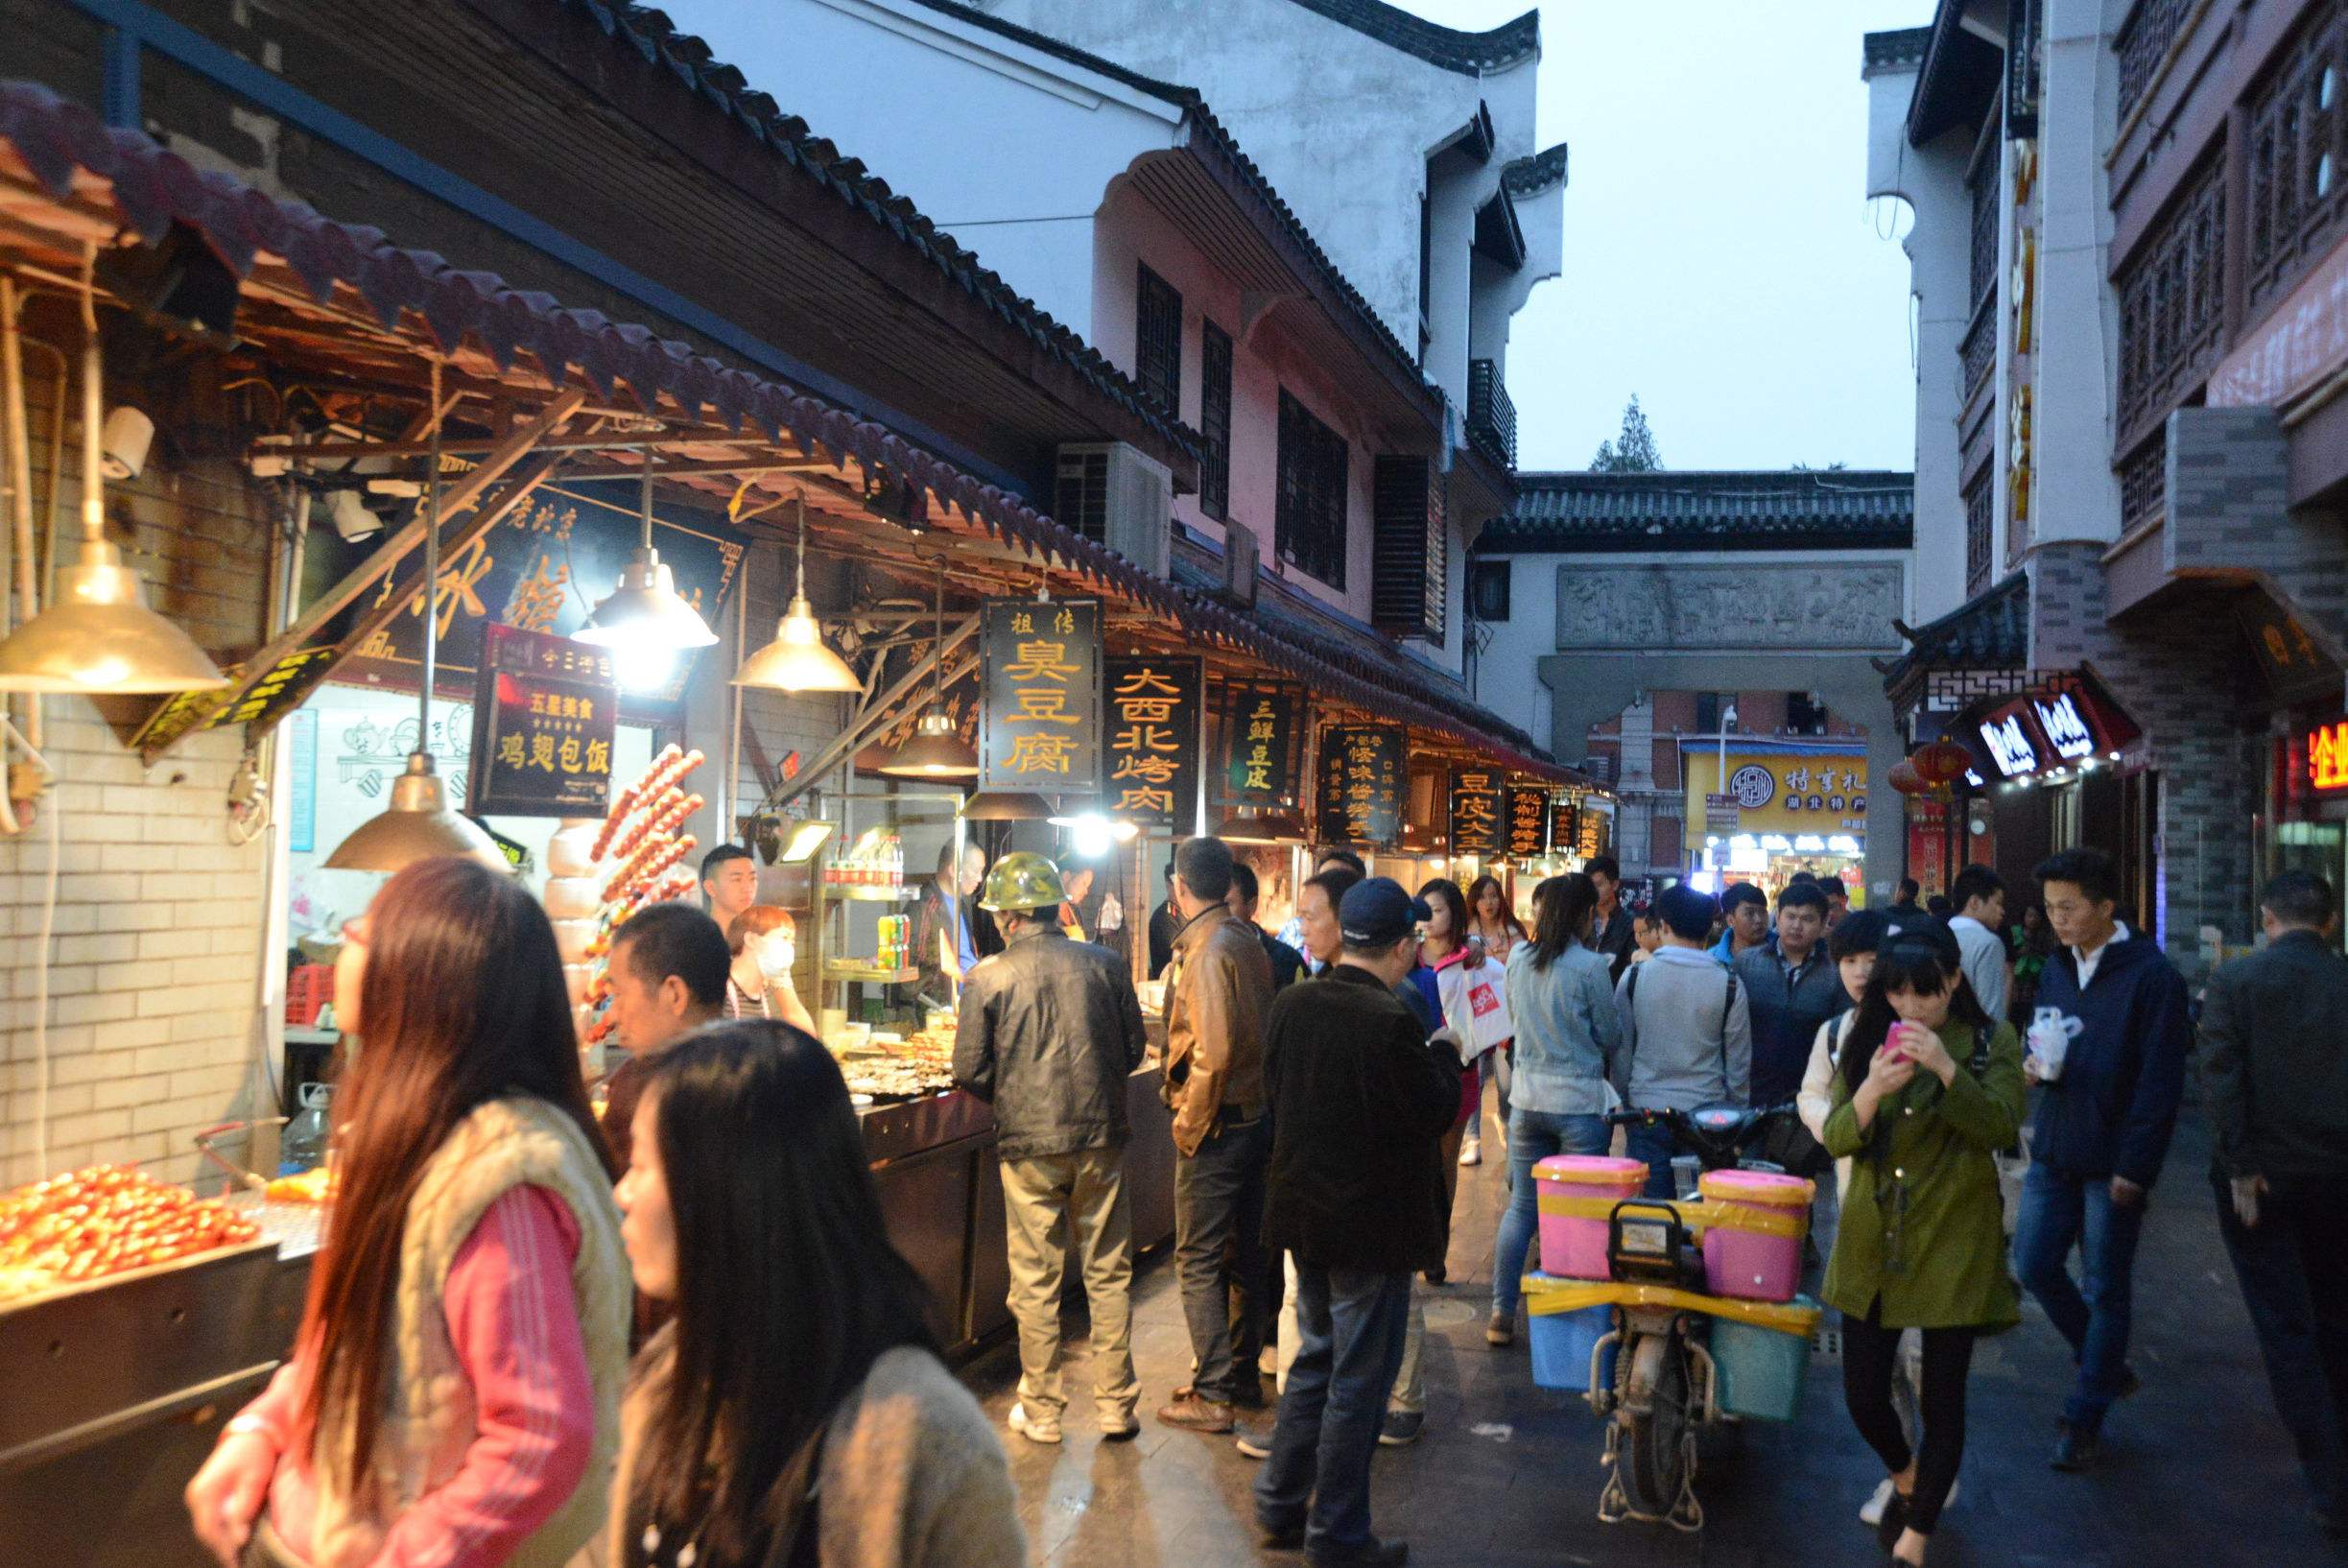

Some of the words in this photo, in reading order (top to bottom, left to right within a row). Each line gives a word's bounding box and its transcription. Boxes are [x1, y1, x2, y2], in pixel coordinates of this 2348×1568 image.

[1010, 608, 1076, 635] 祖传
[530, 691, 593, 720] 五星美食
[1000, 639, 1082, 774] 臭豆腐
[497, 731, 610, 774] 鸡翅包饭
[1109, 667, 1182, 813] 大西北烤肉
[1245, 700, 1276, 790] 三鲜豆皮
[1454, 773, 1497, 849] 豆皮大王
[1788, 796, 1865, 811] 湖北特产
